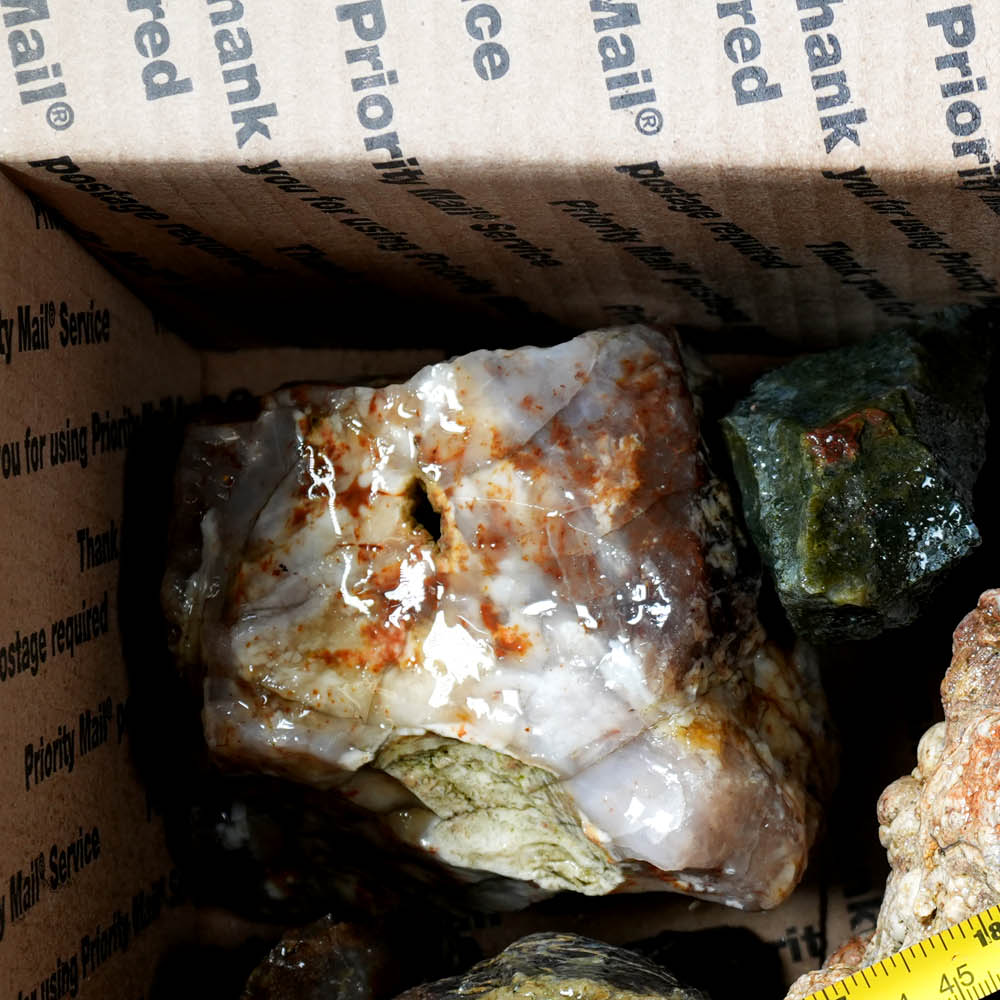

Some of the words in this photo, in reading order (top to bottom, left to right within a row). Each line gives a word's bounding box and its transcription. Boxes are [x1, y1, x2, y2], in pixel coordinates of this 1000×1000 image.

[335, 0, 430, 185] Priority
[237, 160, 318, 193] you
[822, 166, 888, 197] you
[18, 302, 56, 353] Mail®
[59, 299, 110, 348] Service
[24, 427, 46, 475] for
[50, 418, 88, 469] using
[51, 590, 109, 658] required
[24, 725, 75, 792] Priority
[9, 852, 46, 921] Mail®
[49, 826, 101, 891] Service
[938, 964, 975, 995] 45
